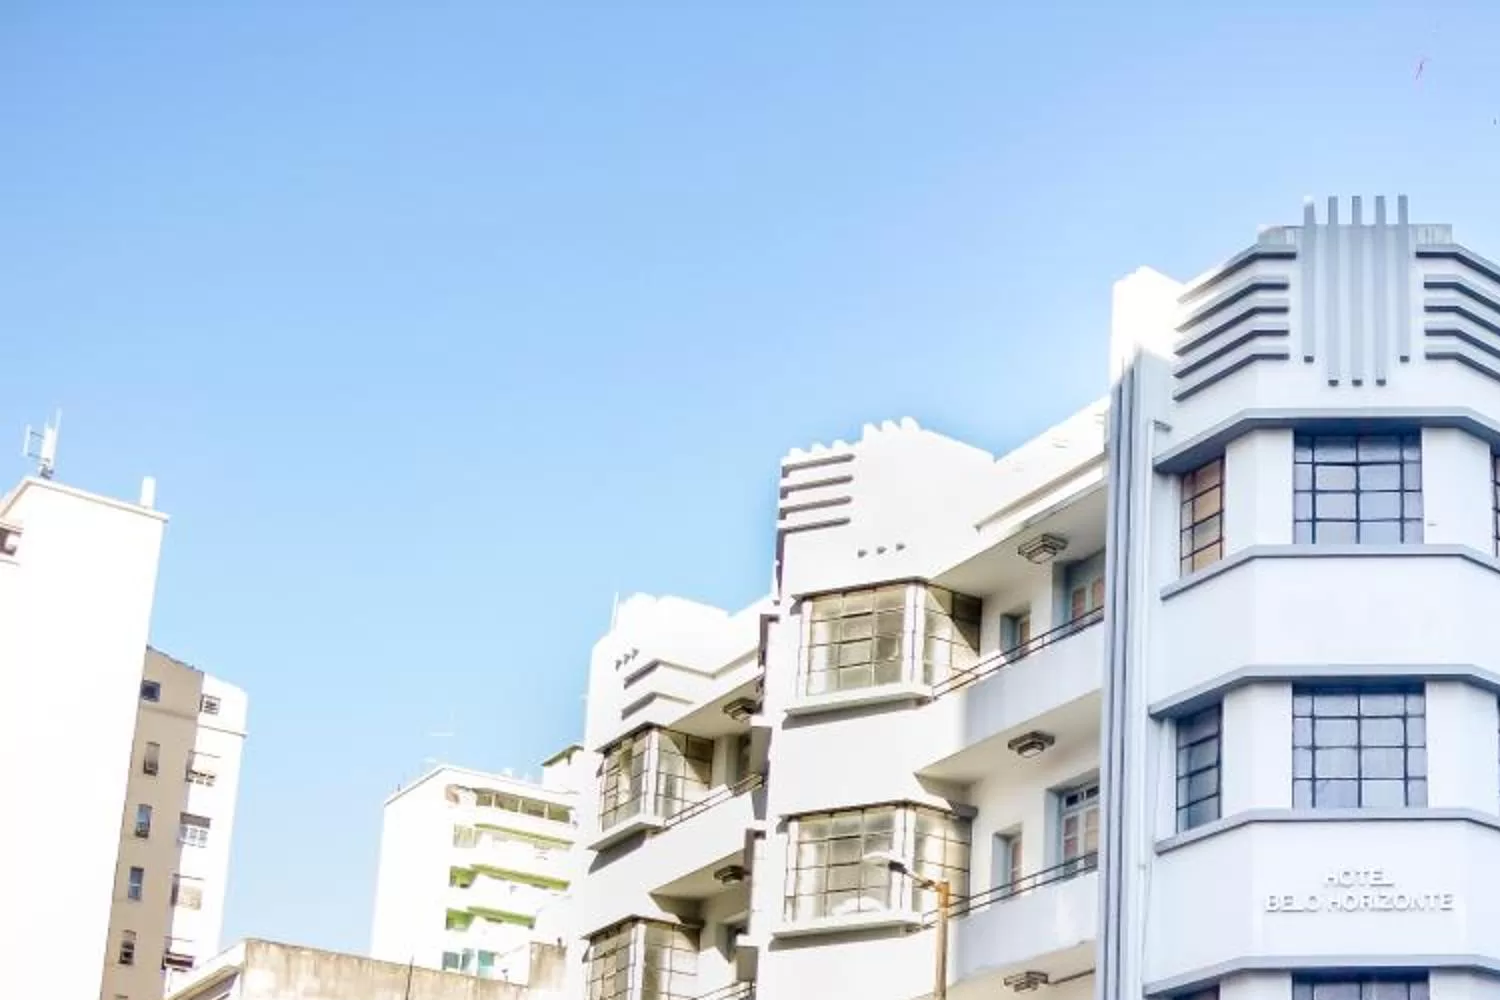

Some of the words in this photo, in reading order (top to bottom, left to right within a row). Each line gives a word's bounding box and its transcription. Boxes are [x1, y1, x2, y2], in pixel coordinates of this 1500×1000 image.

[1323, 866, 1394, 888] HOTEL
[1265, 893, 1320, 913] BELO
[1326, 892, 1455, 913] HORIZONTE
